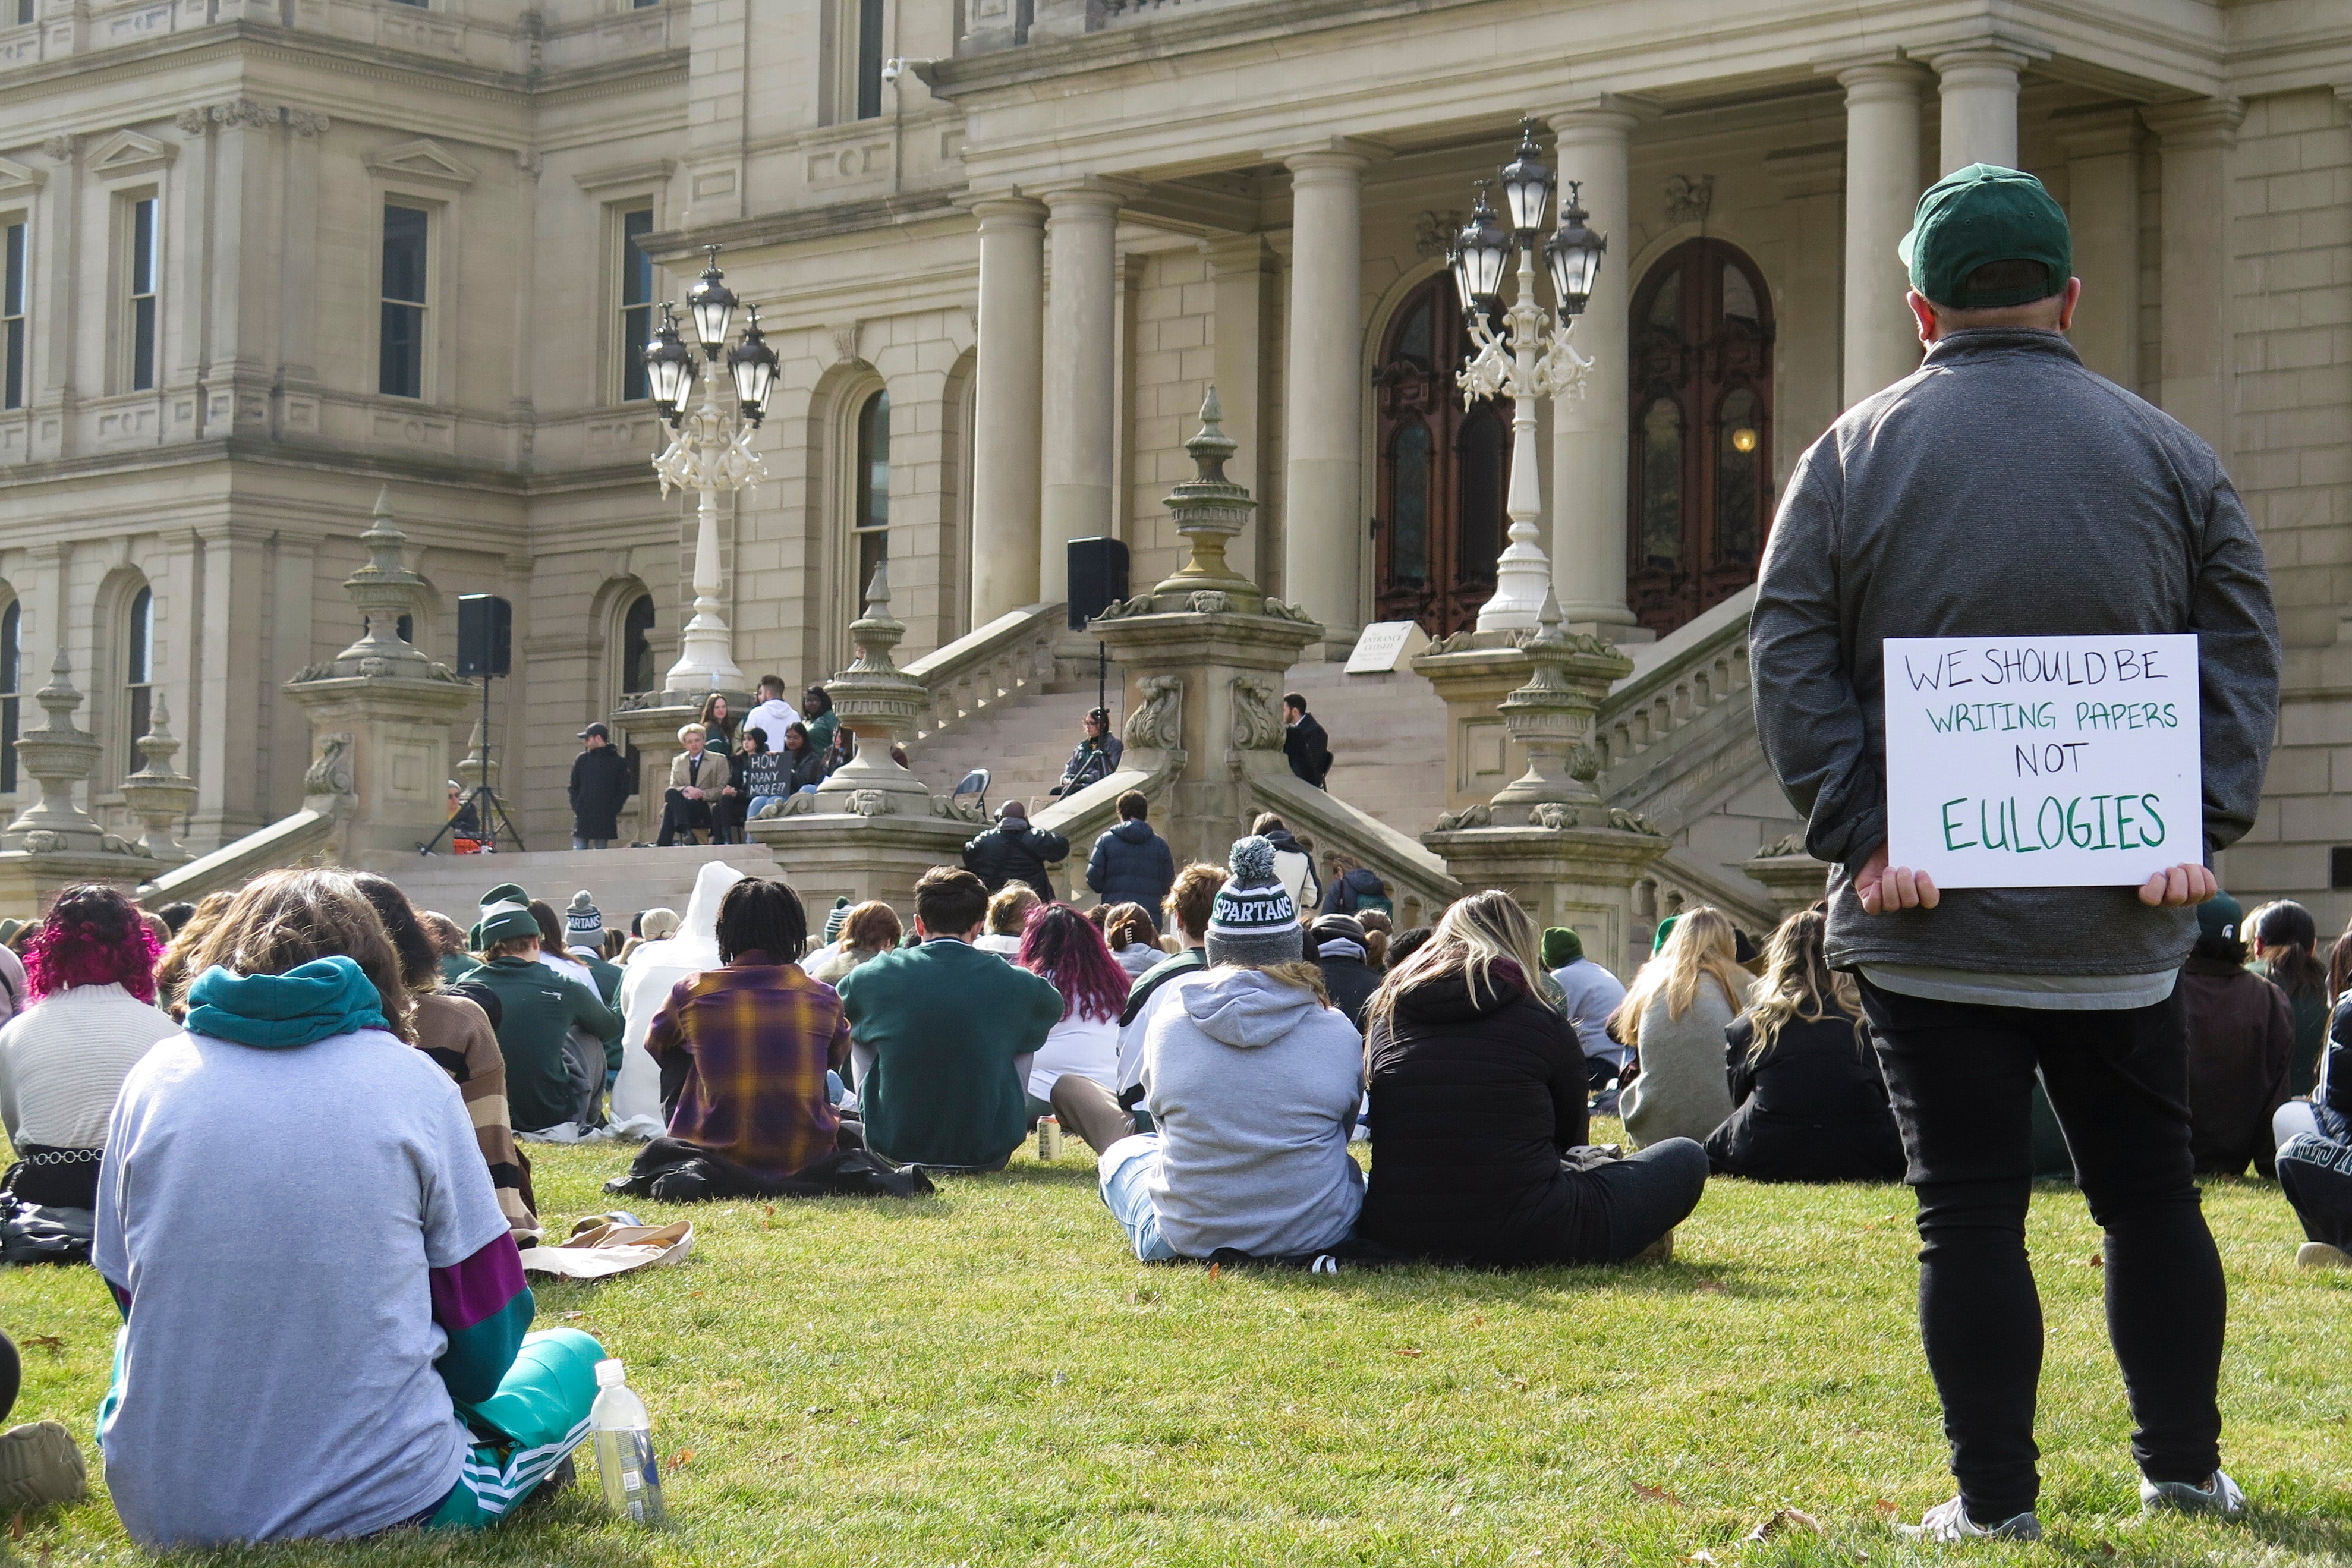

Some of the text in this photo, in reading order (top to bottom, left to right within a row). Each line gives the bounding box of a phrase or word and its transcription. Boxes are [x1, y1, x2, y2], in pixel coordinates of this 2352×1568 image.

[1363, 635, 1402, 643] ENTRANCE
[1905, 648, 2168, 691] WE SHOULD BE
[1926, 701, 2178, 733] WRITING PAPERS
[751, 754, 779, 769] HOW
[2015, 742, 2090, 777] NOT
[750, 771, 779, 783] MANY
[749, 782, 786, 795] MORE??
[1942, 792, 2165, 853] EULOGIES
[1213, 895, 1293, 922] SPARTANS
[567, 915, 600, 928] ARTANS
